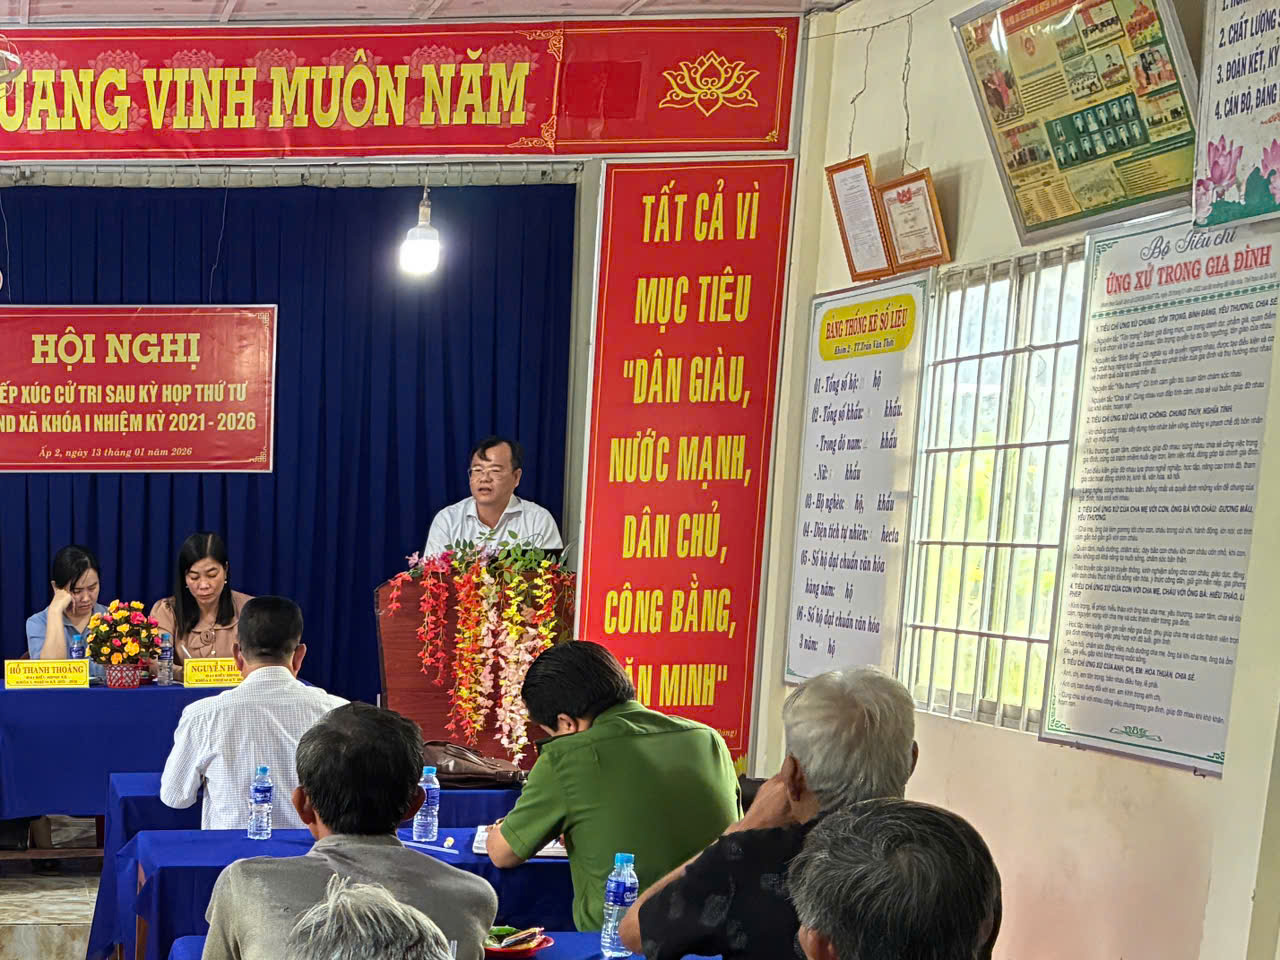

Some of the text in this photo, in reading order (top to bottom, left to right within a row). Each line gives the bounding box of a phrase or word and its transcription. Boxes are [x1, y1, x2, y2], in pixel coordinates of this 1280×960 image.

[1228, 11, 1248, 45] CHẤT
[1250, 8, 1276, 38] LƯỢNG
[142, 65, 256, 131] VINH
[269, 47, 408, 129] MUÔN
[419, 46, 529, 127] NĂM
[1226, 52, 1247, 82] ĐOÀN
[1223, 90, 1239, 118] CÁN
[1255, 78, 1277, 108] ĐẢNG
[642, 178, 760, 242] TẤT CẢ VÌ
[1106, 271, 1131, 295] ỨNG
[1134, 262, 1154, 291] XỬ
[1157, 259, 1202, 286] TRONG
[1205, 254, 1230, 278] GIA
[1233, 244, 1272, 273] ĐÌNH
[634, 265, 752, 334] MỤC TIÊU
[31, 326, 201, 371] HỘI NGHỊ
[21, 381, 51, 404] XÚC
[54, 380, 77, 404] CỬ
[78, 385, 102, 404] TRI
[105, 384, 135, 403] SAU
[139, 380, 159, 403] KỲ
[161, 384, 192, 406] HỌP
[195, 379, 226, 402] THỨ
[228, 380, 249, 402] TƯ
[623, 346, 751, 409] "DÂN GIÀU,
[19, 410, 39, 433] XÃ
[41, 410, 82, 433] KHÓA
[85, 414, 90, 433] I
[93, 410, 143, 436] NHIỆM
[146, 409, 165, 432] KỲ
[168, 413, 205, 431] 2021
[217, 412, 256, 431] 2026
[38, 445, 52, 458] Ấp
[65, 448, 88, 458] ngày
[91, 448, 101, 456] 13
[104, 448, 131, 458] tháng
[134, 448, 145, 456] 01
[147, 448, 168, 456] năm
[171, 447, 192, 456] 2026
[608, 428, 752, 490] NƯỚC MẠNH,
[622, 500, 727, 565] DÂN CHỦ,
[604, 573, 736, 639] CÔNG BẰNG,
[23, 666, 50, 674] THANH
[52, 663, 84, 674] THOẢNG
[191, 661, 226, 673] NGUYỄN
[658, 664, 728, 707] MINH"
